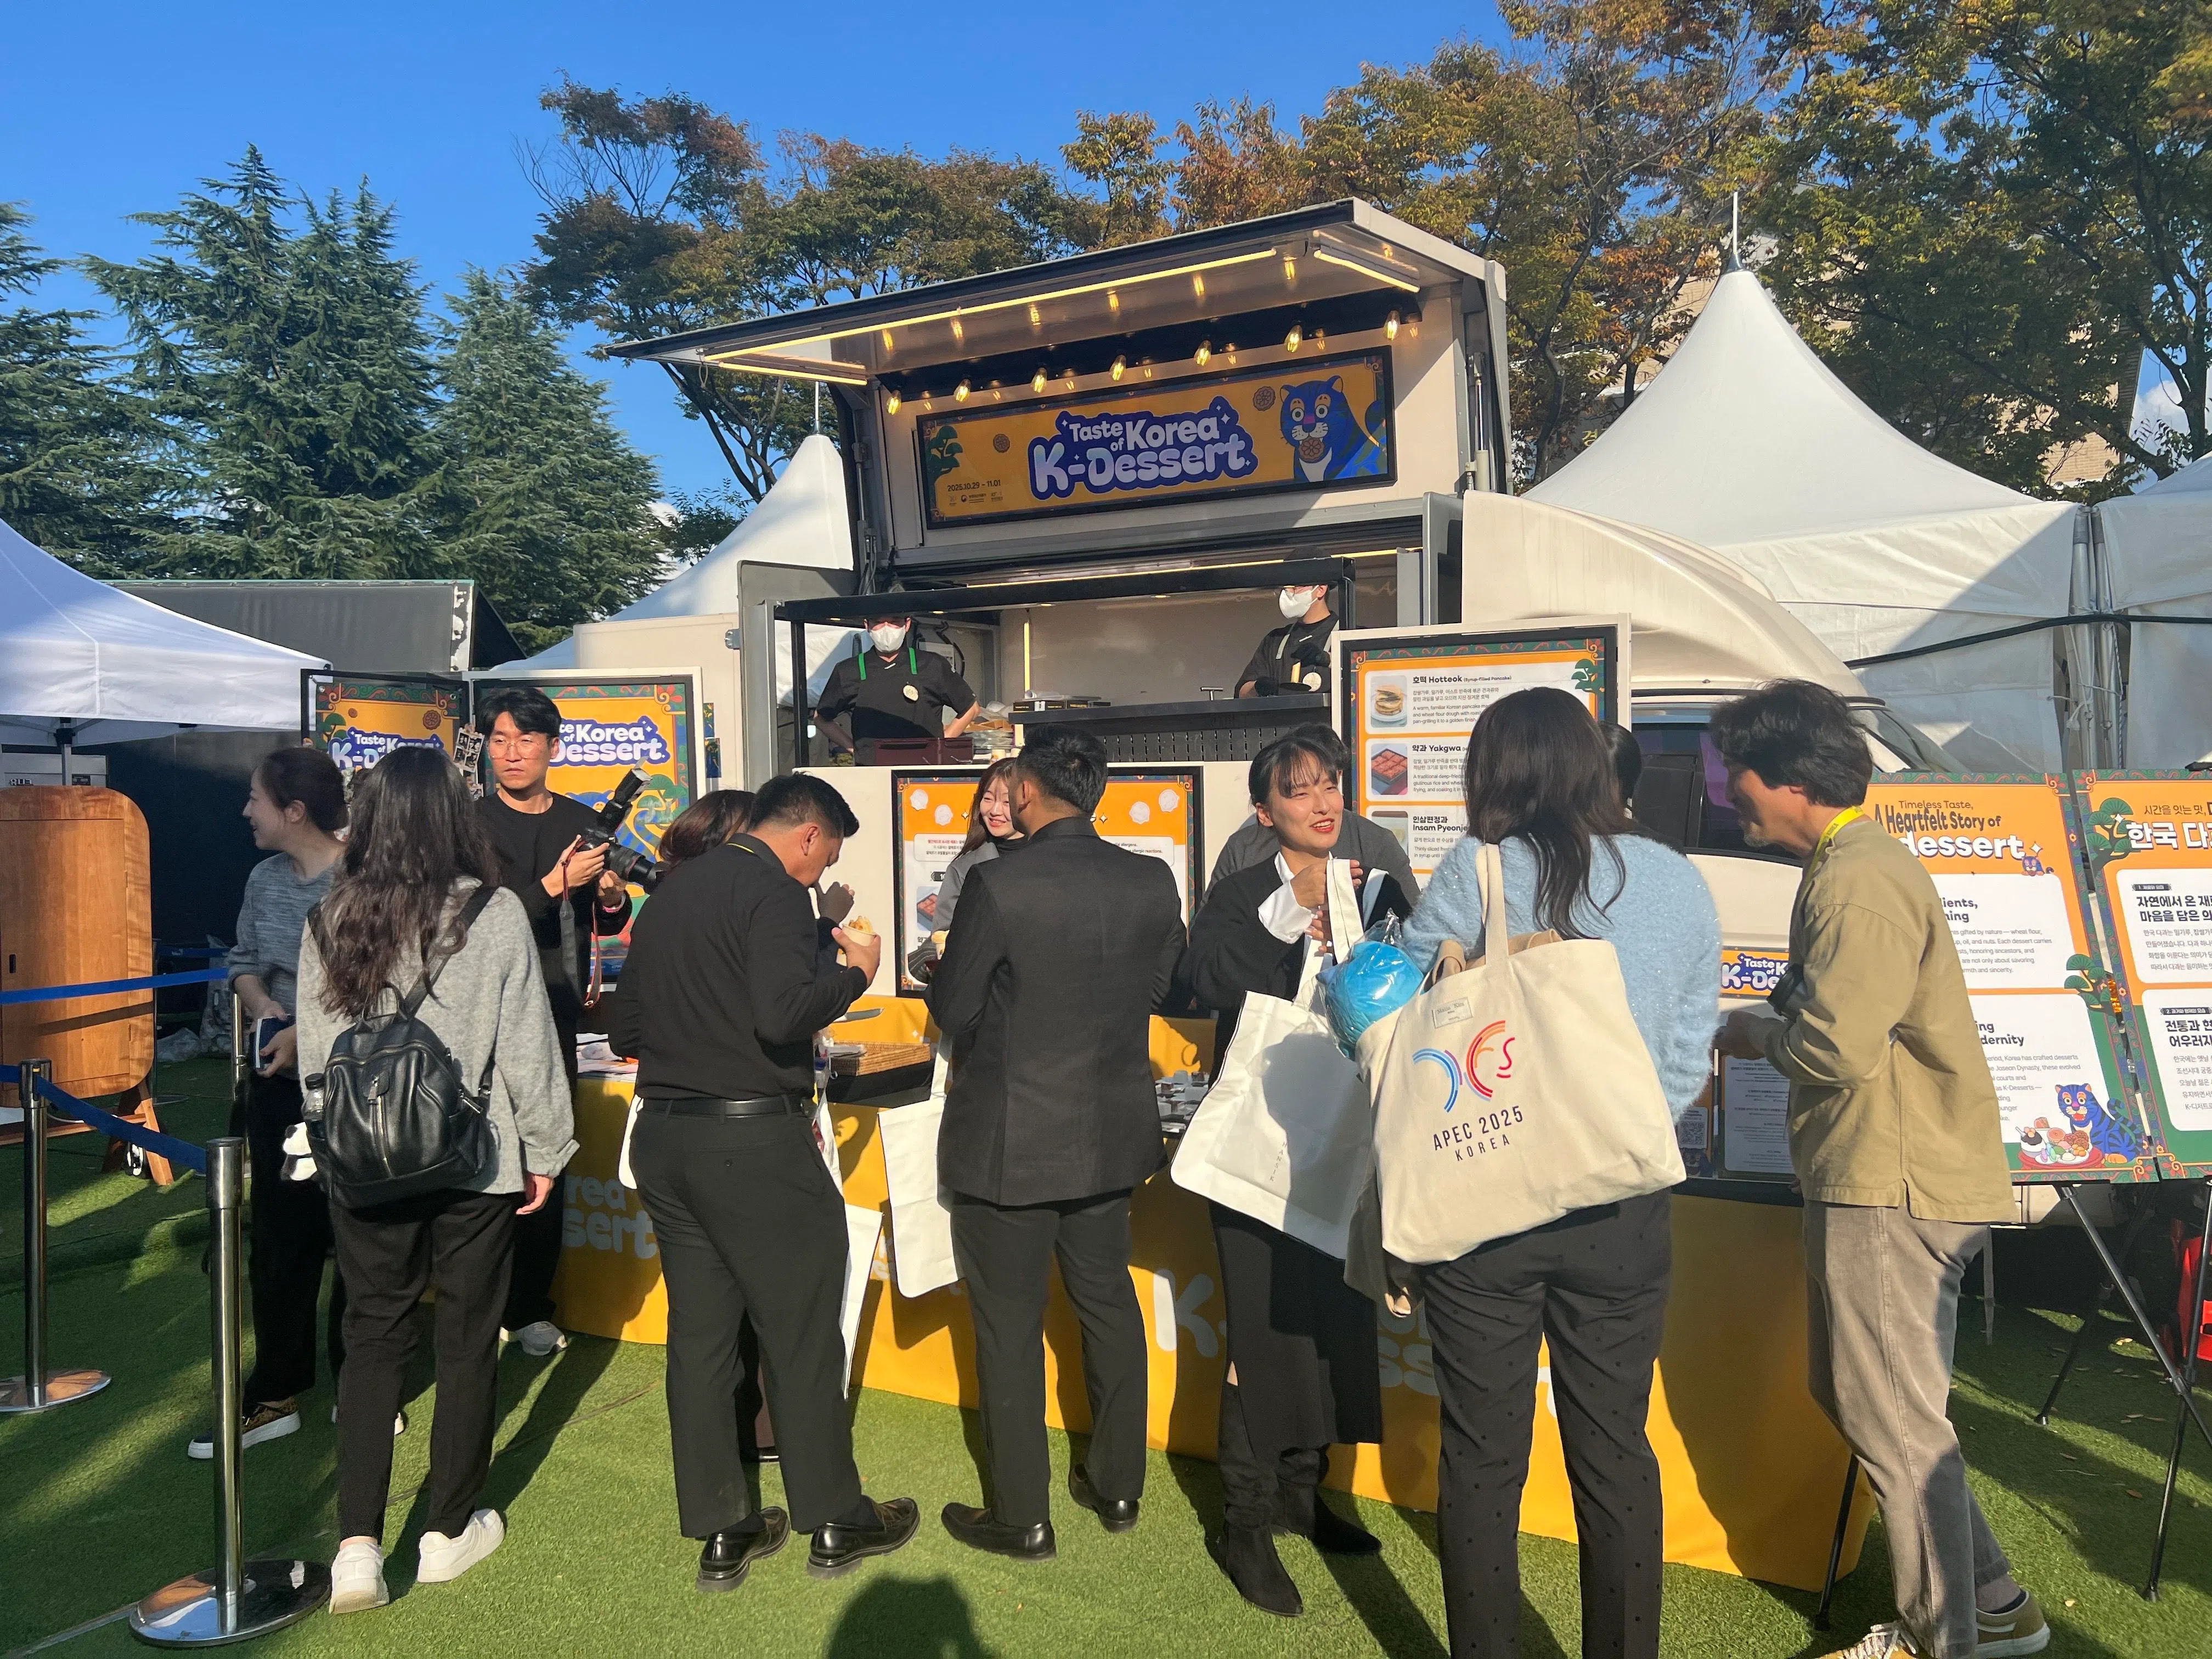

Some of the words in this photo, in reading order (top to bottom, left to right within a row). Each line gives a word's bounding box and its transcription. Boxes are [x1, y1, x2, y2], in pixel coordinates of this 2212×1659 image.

[1069, 420, 1123, 442] Taste
[1110, 438, 1125, 452] of
[1125, 417, 1220, 450] Korea
[1034, 433, 1245, 493] K-Dessert
[947, 482, 980, 492] 2025.10.29
[1413, 676, 1426, 684] 호떡
[1429, 675, 1463, 684] Hotteok
[355, 733, 385, 745] Taste
[563, 733, 575, 742] of
[576, 724, 645, 742] Korea
[1429, 745, 1461, 753] Yakgwa
[1898, 800, 1942, 809] Timeless
[1944, 800, 1974, 810] Taste,
[2144, 805, 2171, 815] 시간을
[2194, 805, 2207, 816] 맛,
[1885, 804, 1948, 833] Heartfelt
[1949, 811, 1984, 831] Story
[1987, 816, 2001, 827] of
[2126, 821, 2179, 850] 한국
[2136, 895, 2182, 907] 자연에서
[2185, 895, 2196, 907] 온
[2140, 910, 2175, 922] 마음을
[2176, 910, 2200, 922] 담은
[1744, 958, 1775, 968] Taste
[2165, 1019, 2200, 1032] 전통과
[1433, 1122, 1472, 1151] APEC
[1479, 1105, 1523, 1135] 2025
[1455, 1134, 1510, 1161] KOREA
